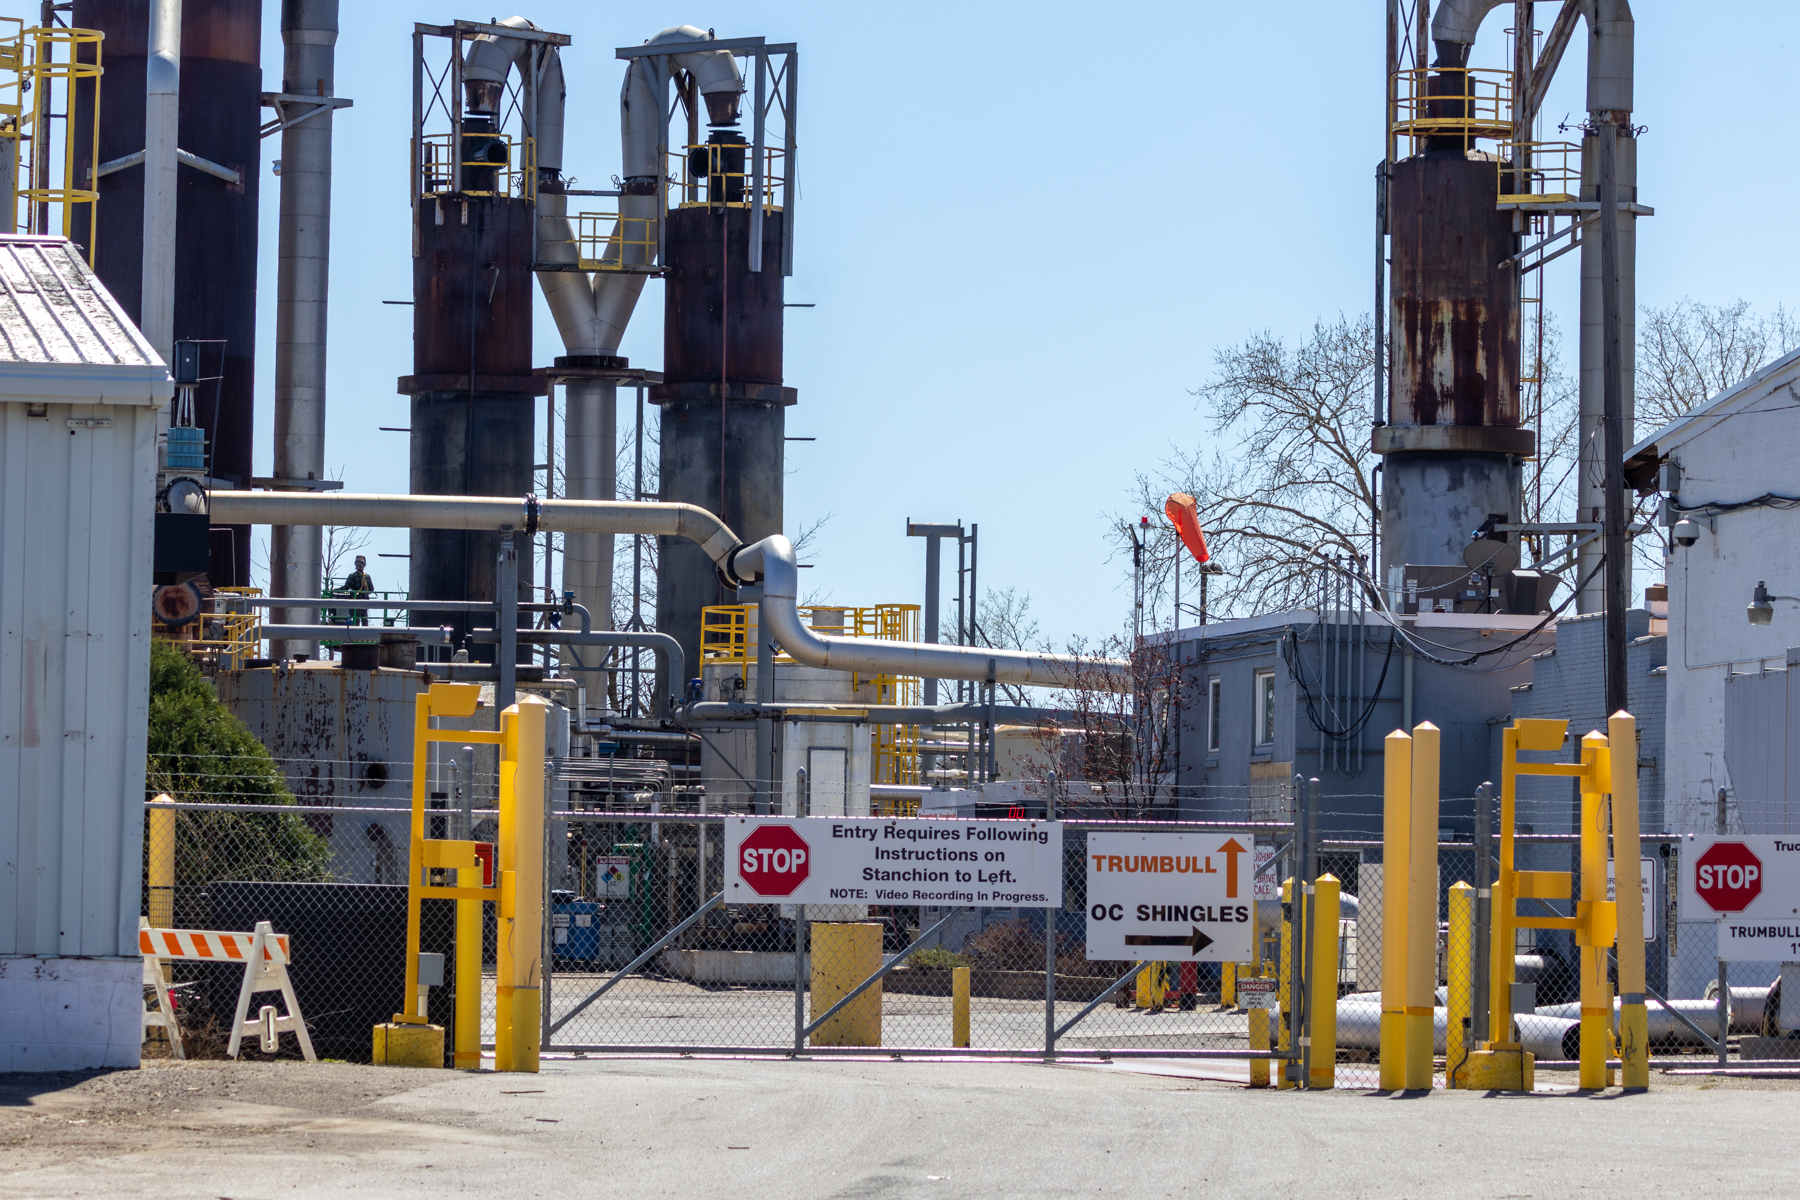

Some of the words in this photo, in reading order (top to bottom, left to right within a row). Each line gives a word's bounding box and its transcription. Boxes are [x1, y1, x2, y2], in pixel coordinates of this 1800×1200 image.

[832, 824, 878, 842] Entry
[883, 825, 960, 843] Requires
[966, 826, 1049, 845] Following
[742, 848, 806, 874] STOP
[875, 846, 978, 862] Instructions
[984, 850, 1005, 862] on
[1092, 855, 1217, 874] TRUMBULL
[862, 866, 949, 882] Stanchion
[955, 869, 972, 883] to
[978, 869, 1017, 884] Left.
[1699, 864, 1759, 889] STOP
[829, 888, 868, 899] NOTE:
[875, 889, 909, 900] Video
[912, 890, 974, 903] Recording
[977, 890, 989, 901] In
[992, 891, 1049, 904] Progress.
[1091, 904, 1124, 922] OC
[1136, 904, 1249, 923] SHINGLES
[1791, 943, 1800, 955] 1
